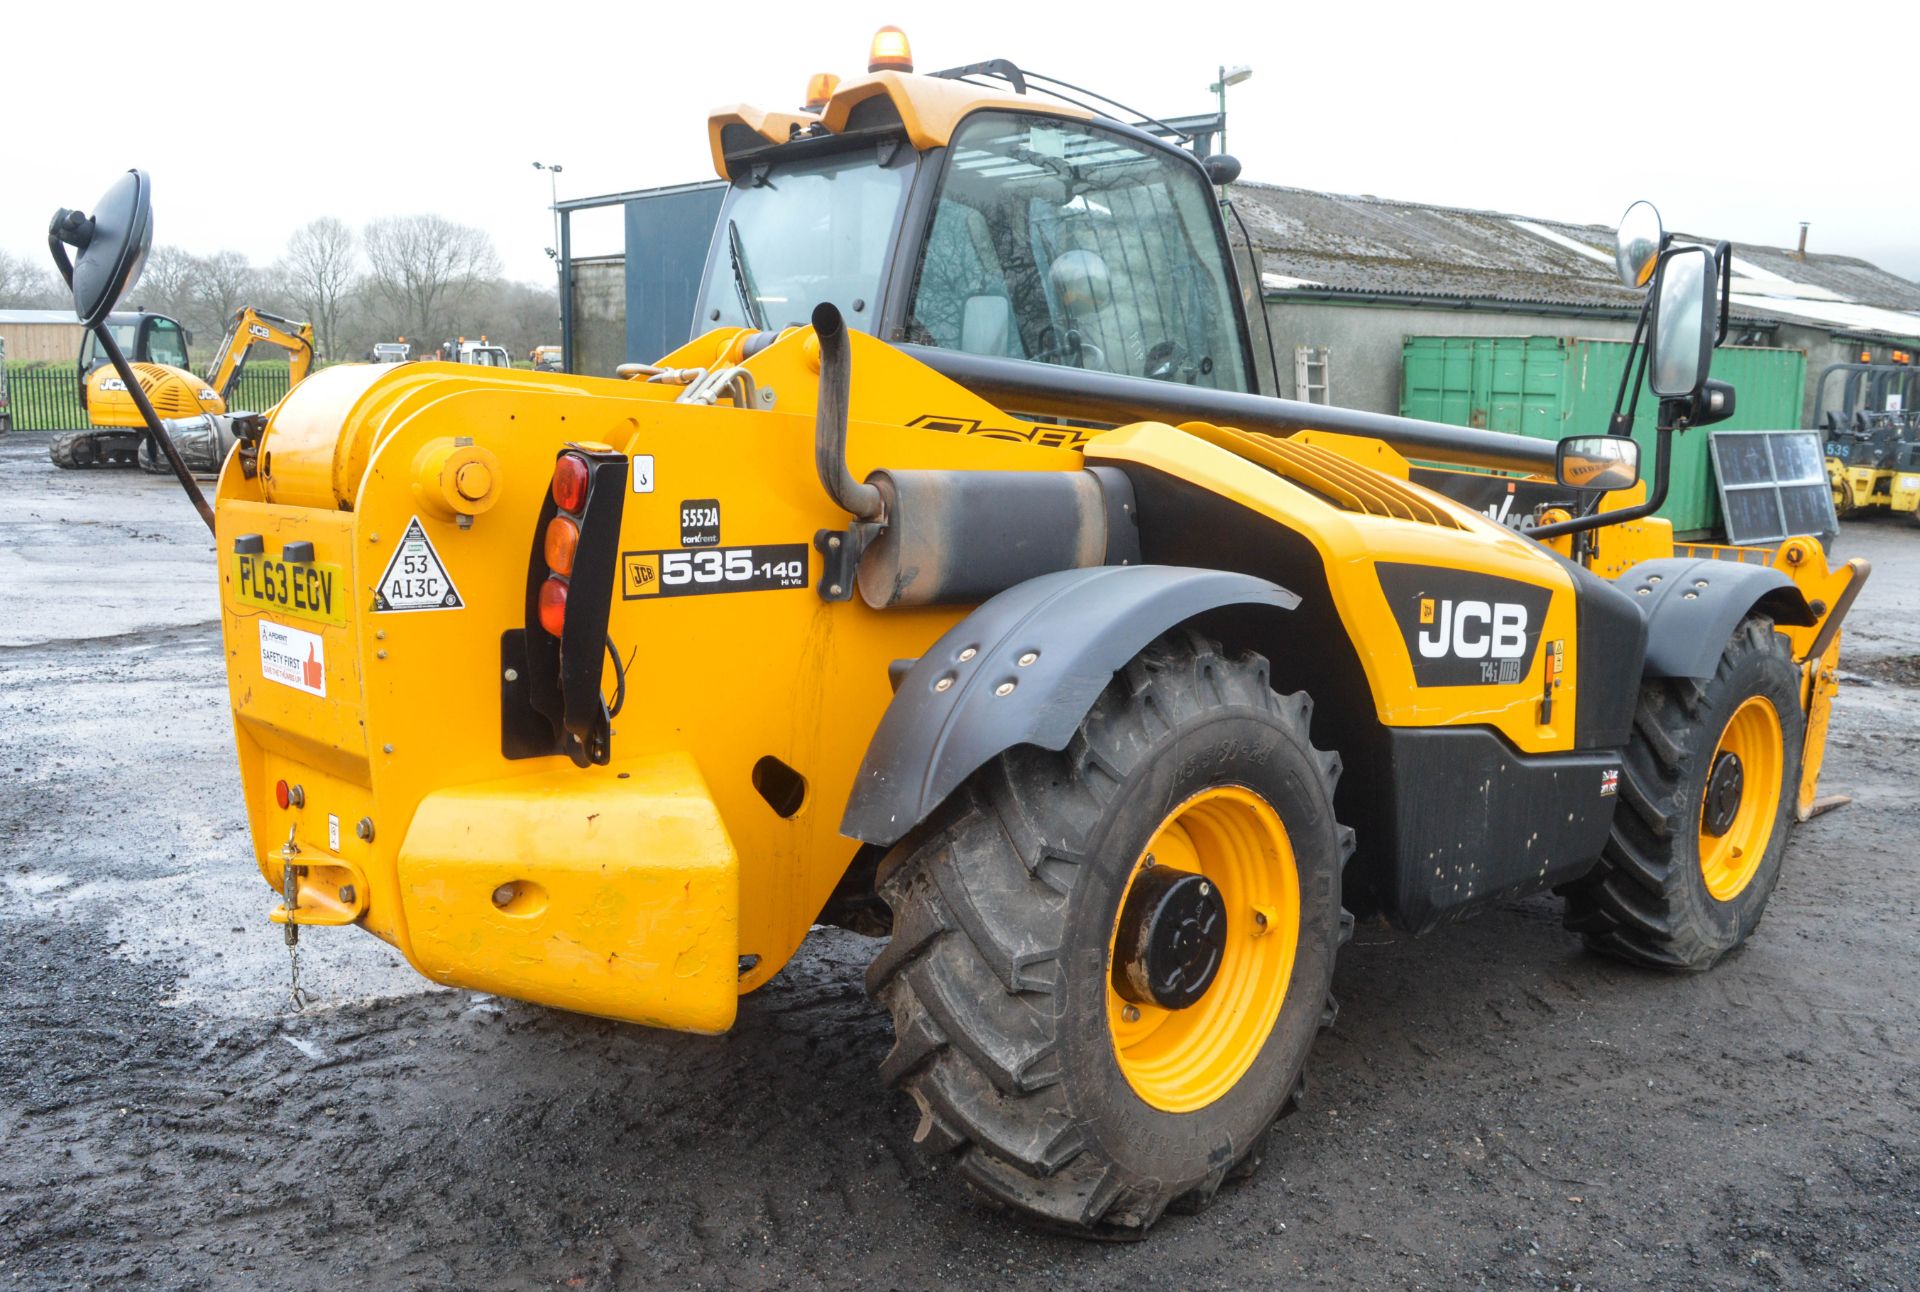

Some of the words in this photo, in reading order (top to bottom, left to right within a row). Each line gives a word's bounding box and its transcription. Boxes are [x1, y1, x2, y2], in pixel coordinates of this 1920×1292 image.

[249, 325, 269, 338] JCB
[682, 507, 719, 527] 5552A
[683, 532, 717, 544] forkrent
[404, 555, 428, 574] 53
[662, 549, 802, 585] 535-140
[239, 555, 288, 605] PL63
[633, 565, 654, 585] JCB
[1419, 599, 1528, 658] JCB
[263, 648, 283, 664] SAFETY
[284, 655, 300, 669] FIRST
